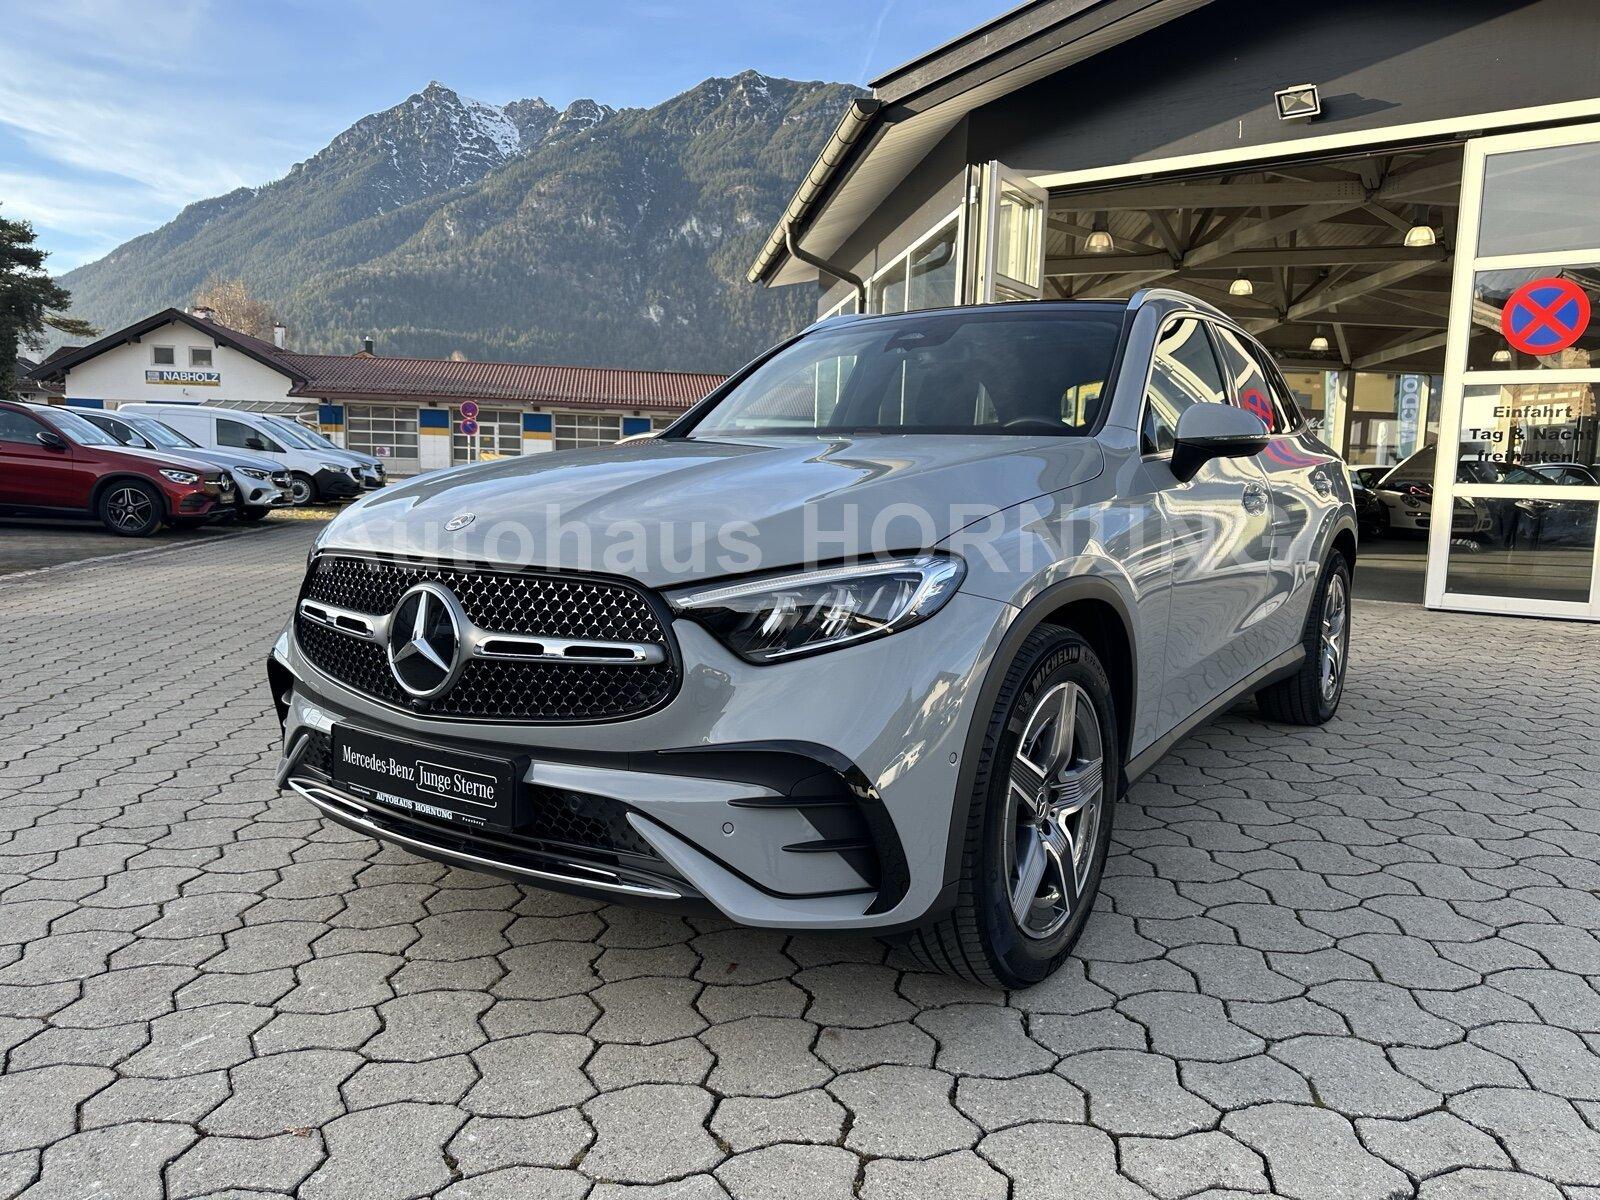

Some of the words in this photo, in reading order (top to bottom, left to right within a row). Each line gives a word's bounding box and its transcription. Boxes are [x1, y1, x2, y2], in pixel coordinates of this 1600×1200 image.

[163, 371, 219, 382] NABHOLZ
[1493, 405, 1573, 418] Einfahrt
[1469, 428, 1504, 443] Tag
[1513, 427, 1525, 440] &
[1533, 428, 1593, 440] Nacht
[1478, 450, 1579, 462] freihalten!
[1033, 647, 1079, 694] MICHELIN
[342, 744, 415, 781] Mercedes-Benz
[419, 765, 451, 793] Junge
[453, 774, 495, 800] Sterne
[376, 792, 413, 809] AUTOHAUS
[415, 801, 453, 820] HORNUNG
